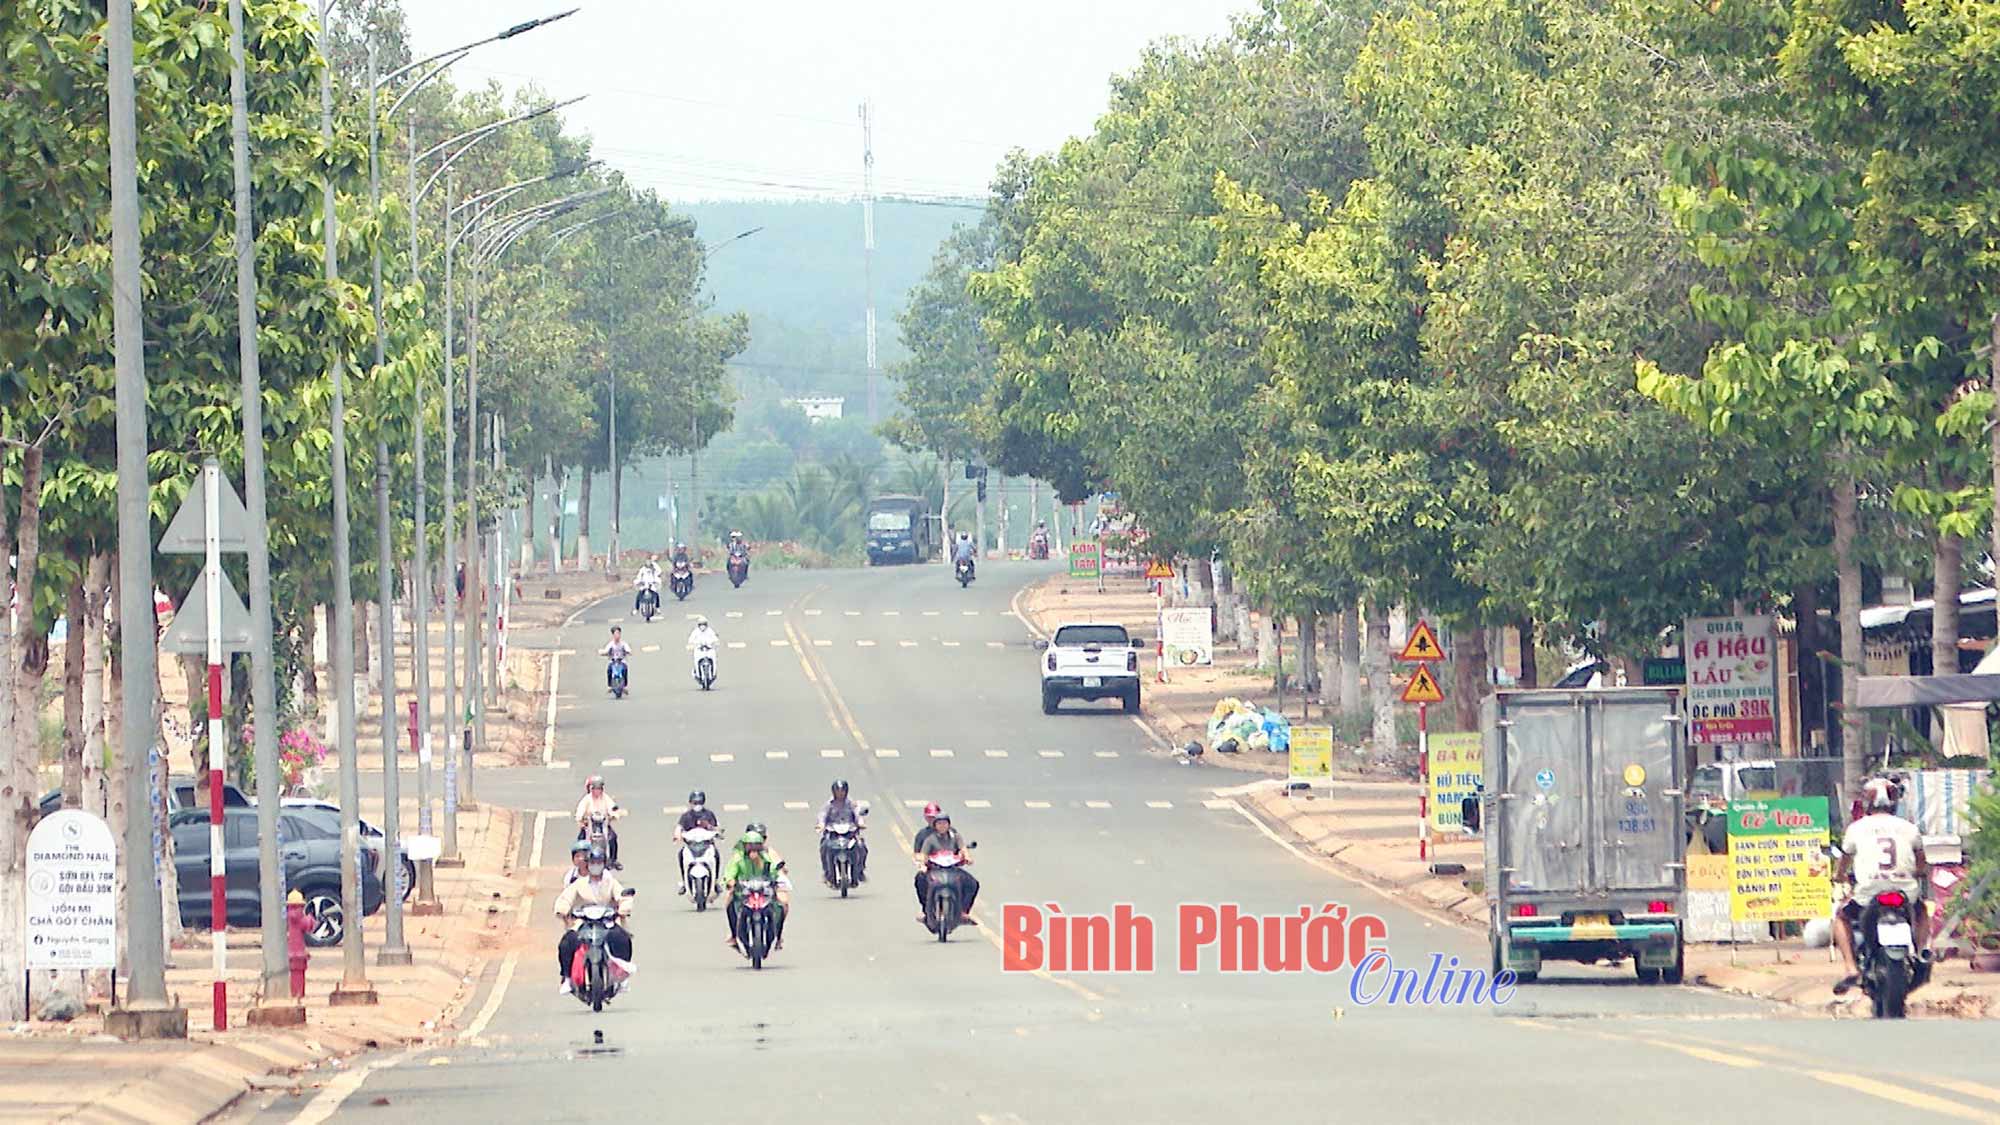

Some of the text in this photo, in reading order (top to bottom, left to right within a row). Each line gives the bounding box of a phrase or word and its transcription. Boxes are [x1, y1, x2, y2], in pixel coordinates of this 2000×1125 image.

[1718, 634, 1765, 660] HẬU
[1740, 700, 1770, 716] 39K
[34, 852, 110, 862] DIAMOND NAIL
[1877, 837, 1897, 870] 3
